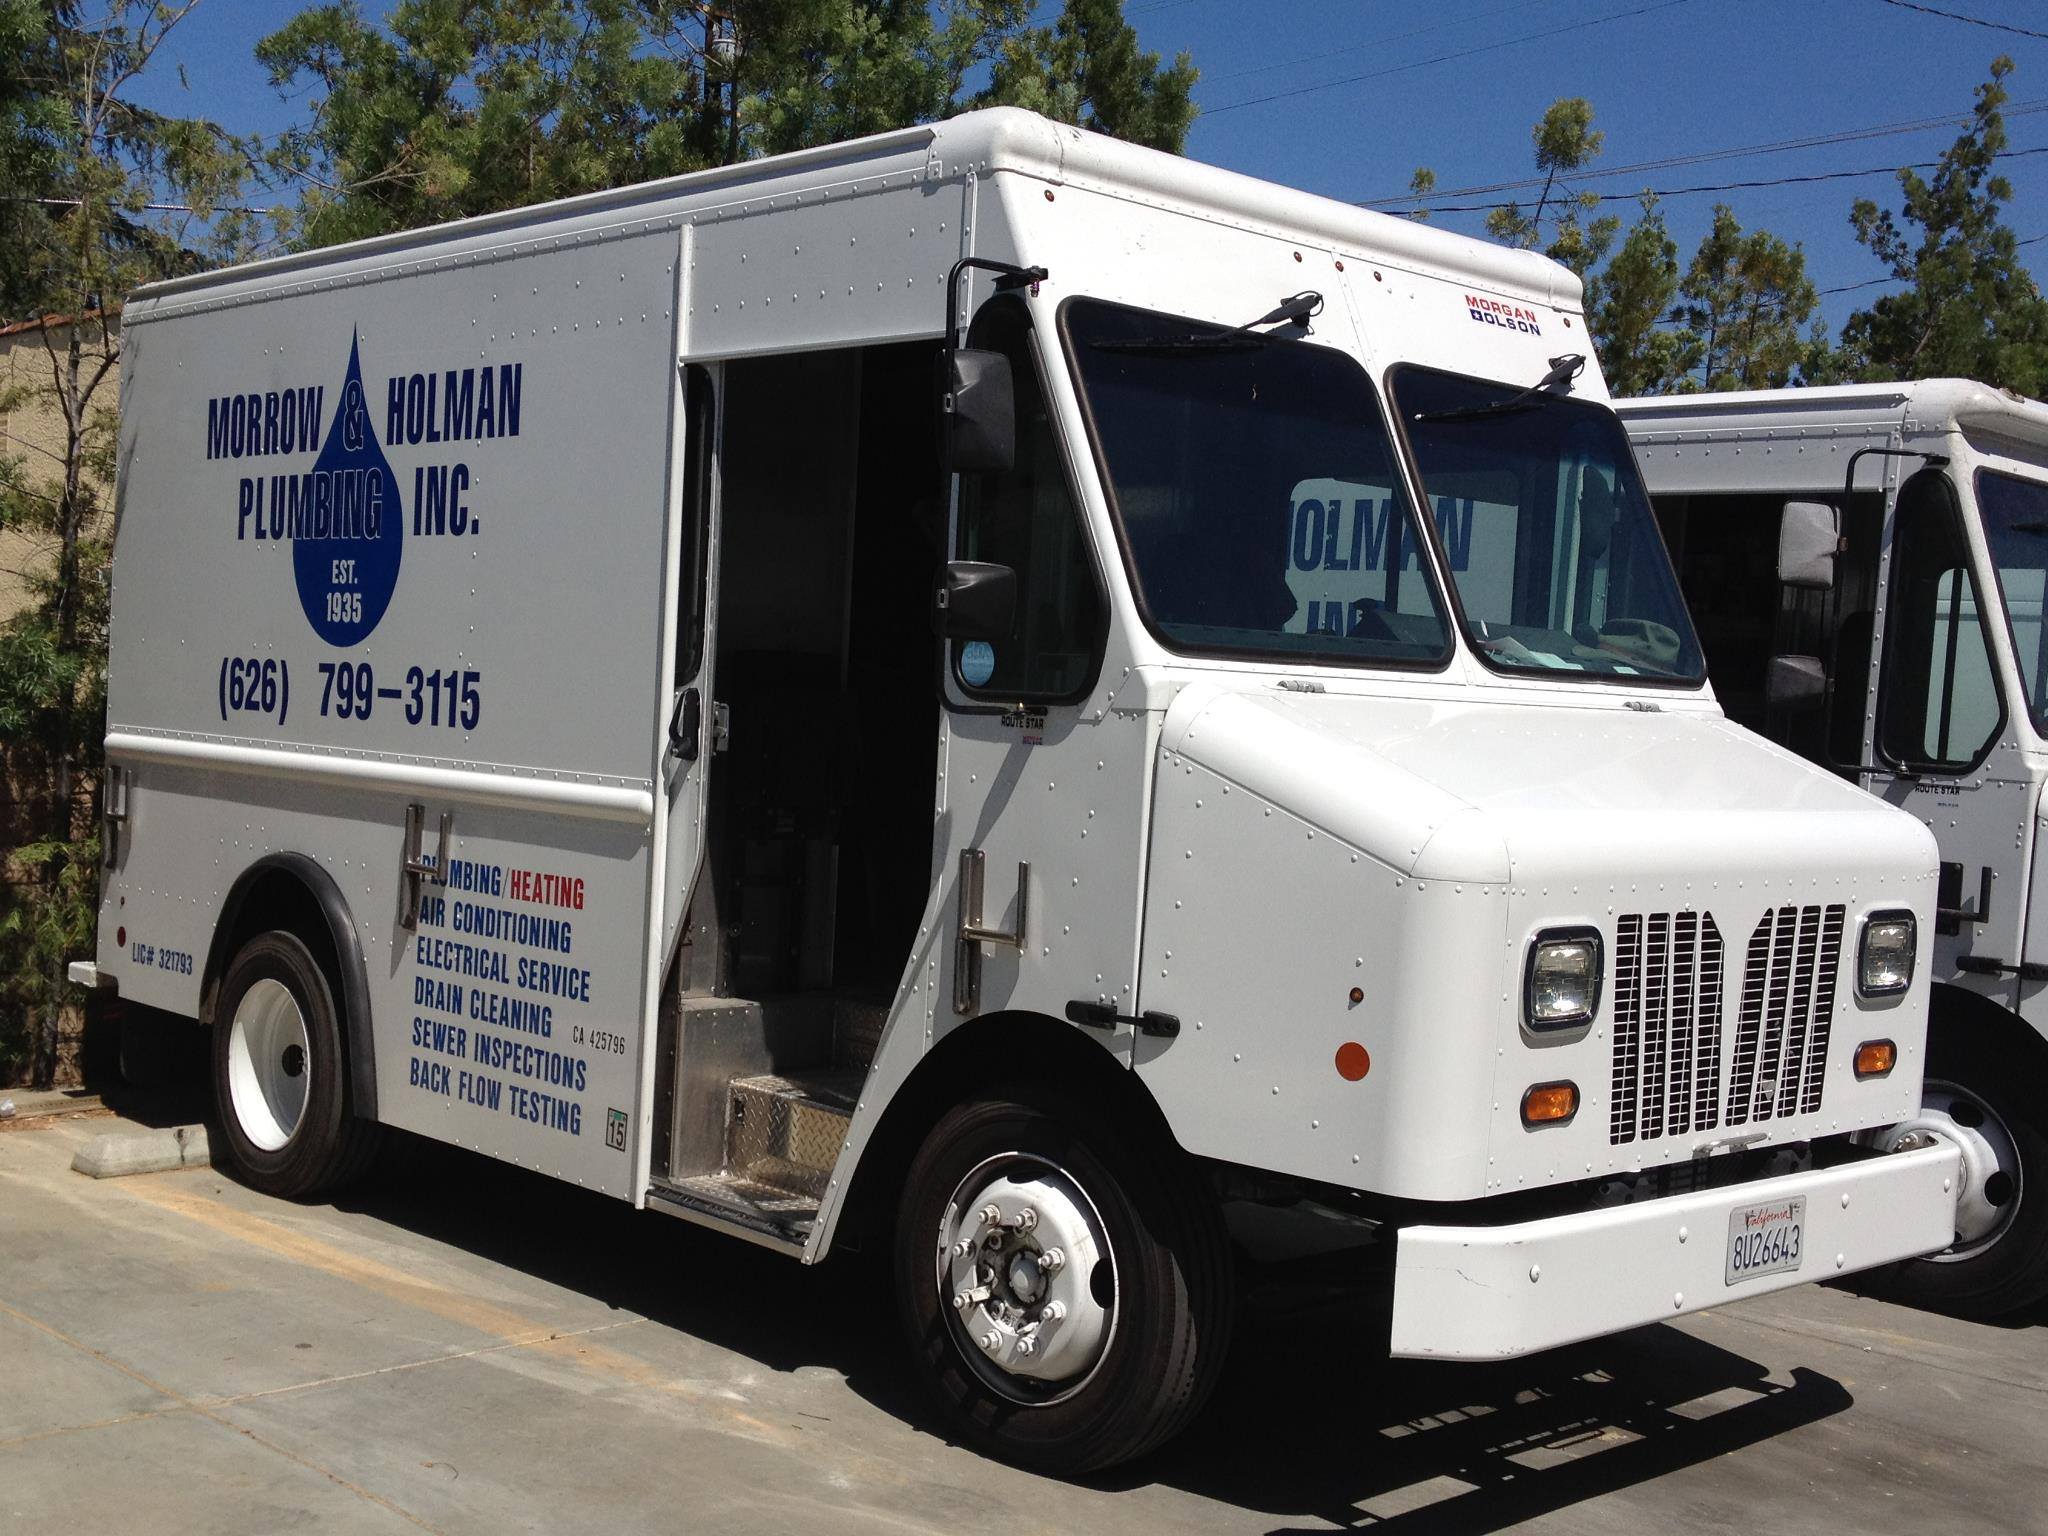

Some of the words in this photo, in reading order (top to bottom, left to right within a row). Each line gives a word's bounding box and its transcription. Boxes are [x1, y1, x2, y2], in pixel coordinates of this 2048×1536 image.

[1465, 294, 1537, 322] MORGAN
[207, 385, 323, 460] MORROW
[342, 380, 363, 451] &
[387, 363, 522, 446] HOLMAN
[237, 467, 384, 540] PLUMBING
[413, 463, 480, 536] INC.
[331, 559, 358, 584] EST.
[326, 592, 362, 623] 1935
[219, 657, 289, 725] (626)
[318, 662, 480, 730] 799-3115
[1915, 784, 1939, 794] ROUTE
[1941, 785, 1961, 796] STAR
[419, 895, 446, 928] AIR
[453, 900, 572, 954] CONDITIONING
[132, 942, 155, 967] LIC#
[158, 948, 193, 975] 321793
[416, 936, 510, 985] ELECTRICAL
[517, 957, 591, 1003] SERVICE
[414, 976, 463, 1016] DRAIN
[470, 988, 553, 1038] CLEANING
[412, 1016, 466, 1058] SEWER
[474, 1032, 588, 1092] INSPECTIONS
[573, 1025, 584, 1045] CA
[590, 1029, 626, 1055] 425796
[409, 1056, 451, 1097] BACK
[458, 1071, 502, 1112] FLOW
[509, 1085, 581, 1137] TESTING
[609, 1120, 625, 1147] 15
[1745, 1207, 1792, 1229] California
[1733, 1224, 1801, 1271] 8U26643
